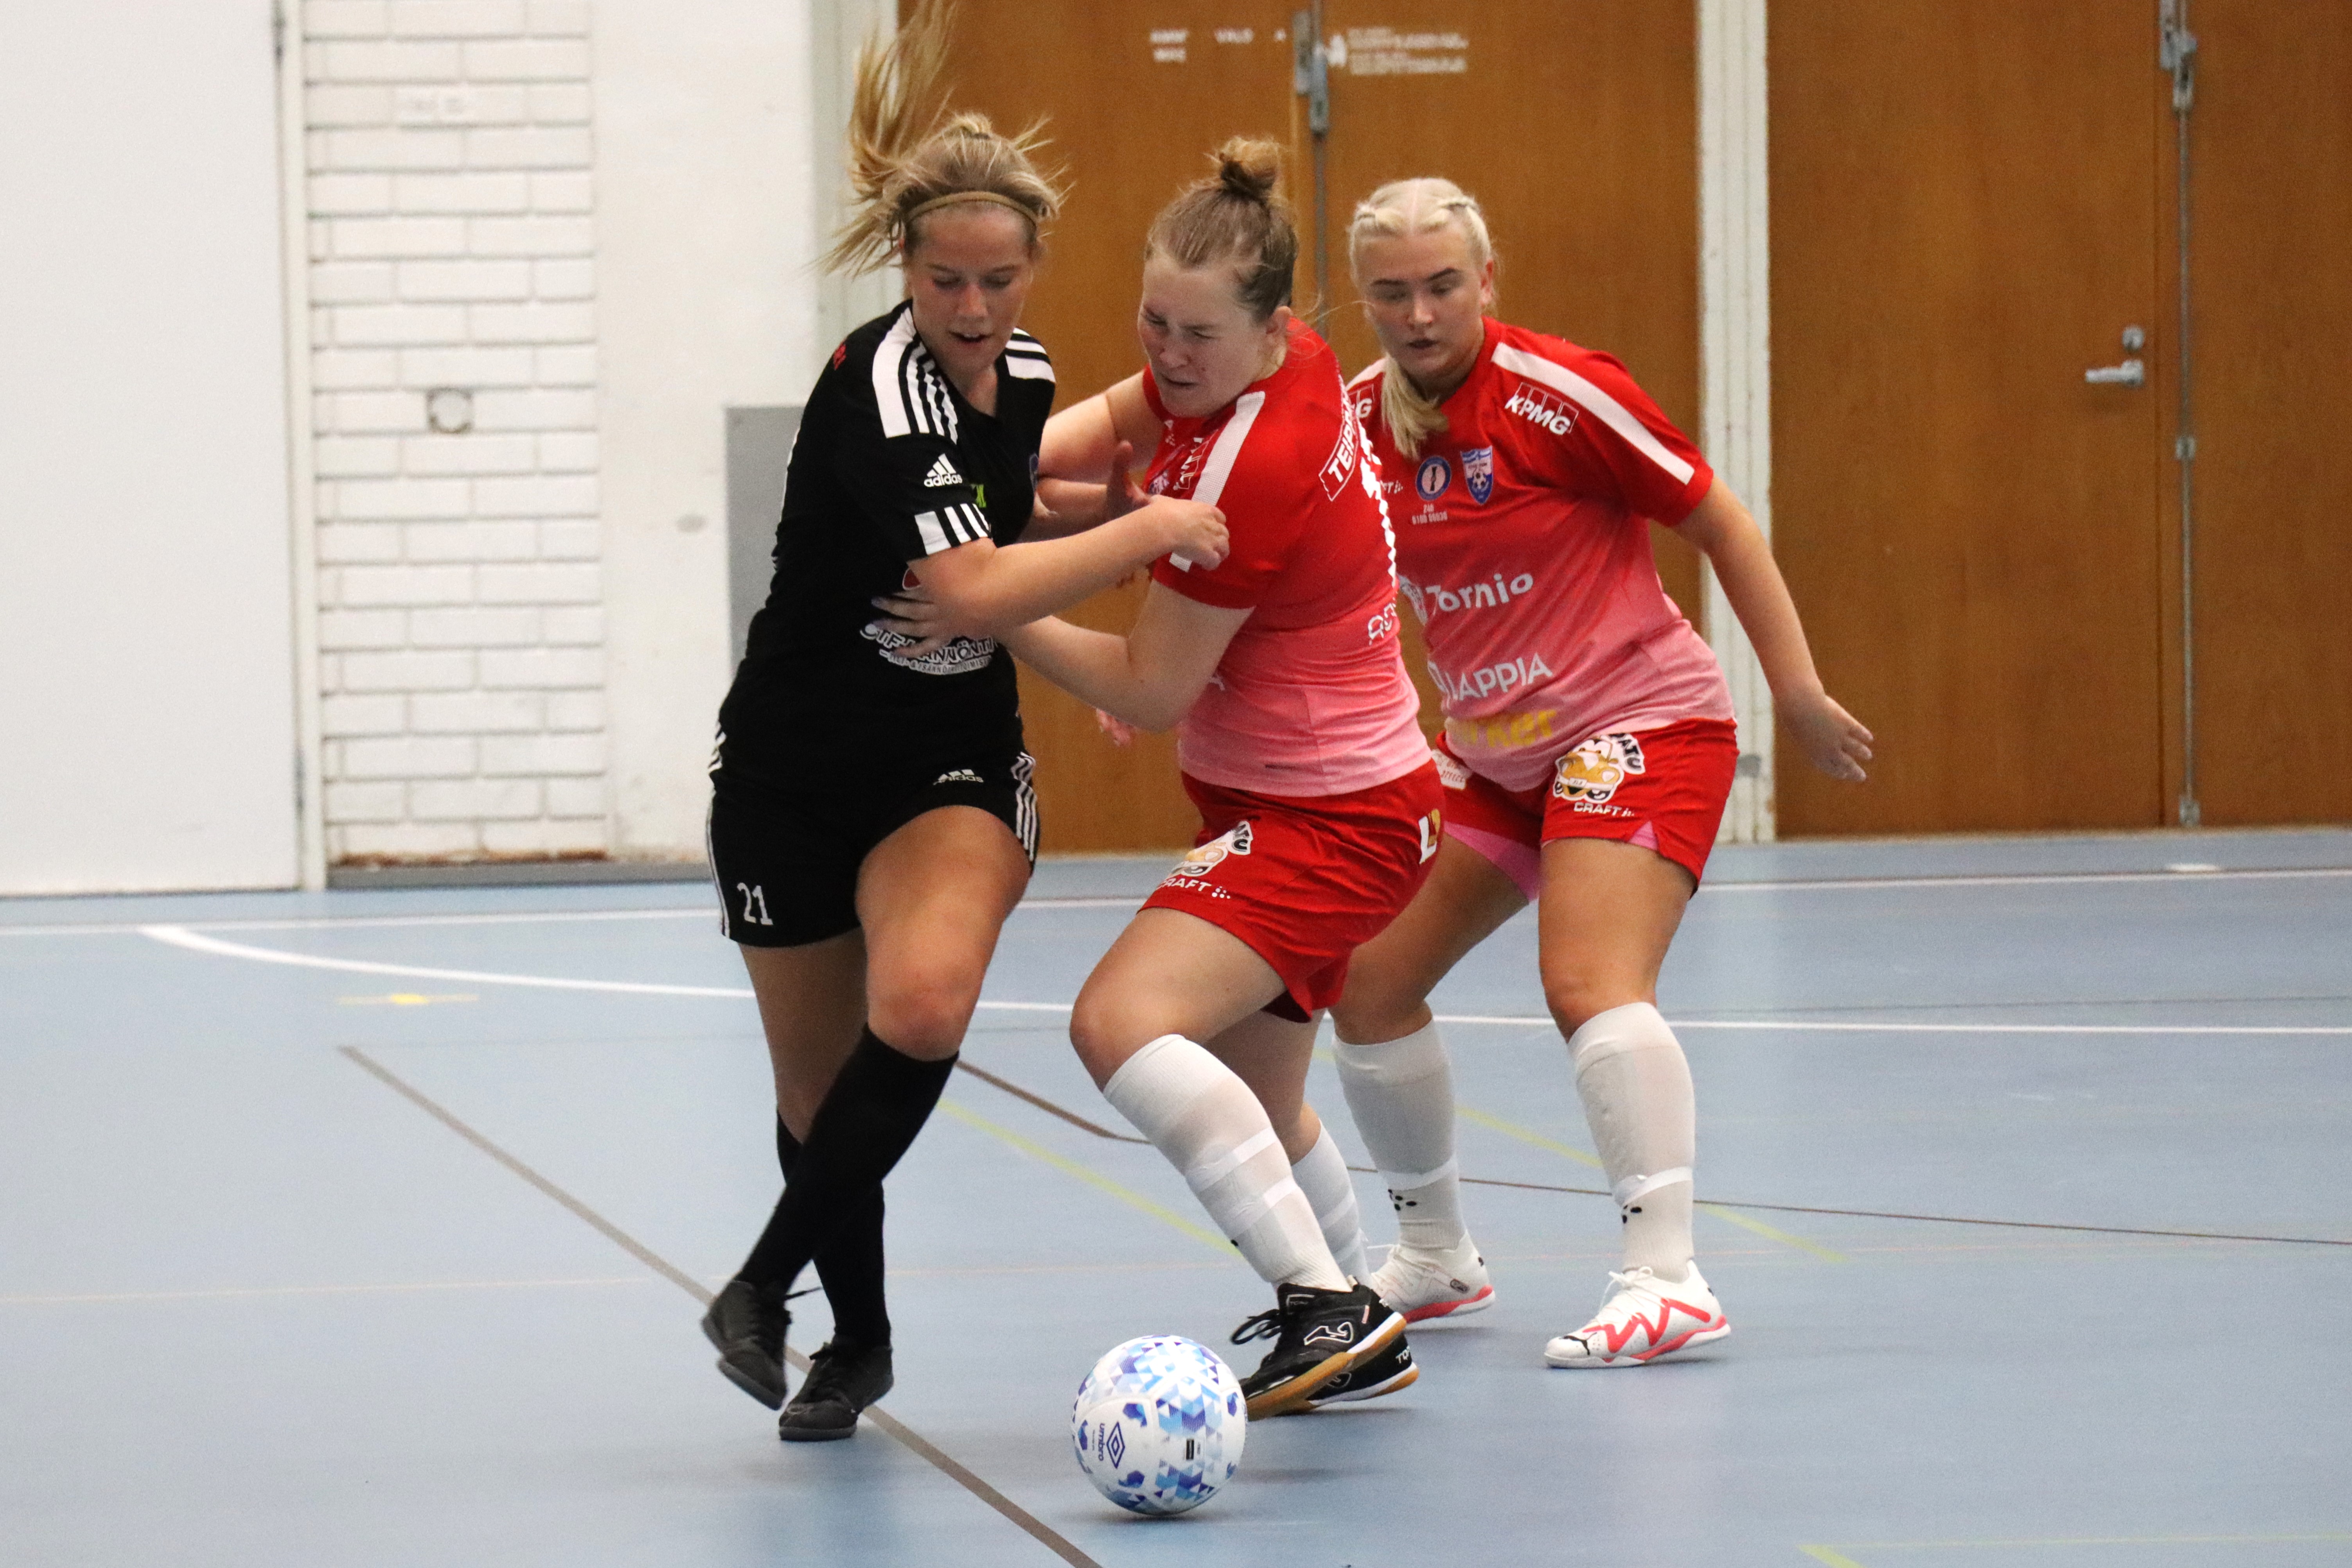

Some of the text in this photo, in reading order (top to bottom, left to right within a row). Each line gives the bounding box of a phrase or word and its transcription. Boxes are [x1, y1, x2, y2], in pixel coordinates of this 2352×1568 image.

[1505, 395, 1571, 435] KPMG
[924, 473, 963, 487] adidas
[1426, 573, 1533, 611] Tornio
[1574, 802, 1622, 816] CRAFT
[737, 882, 773, 925] 21
